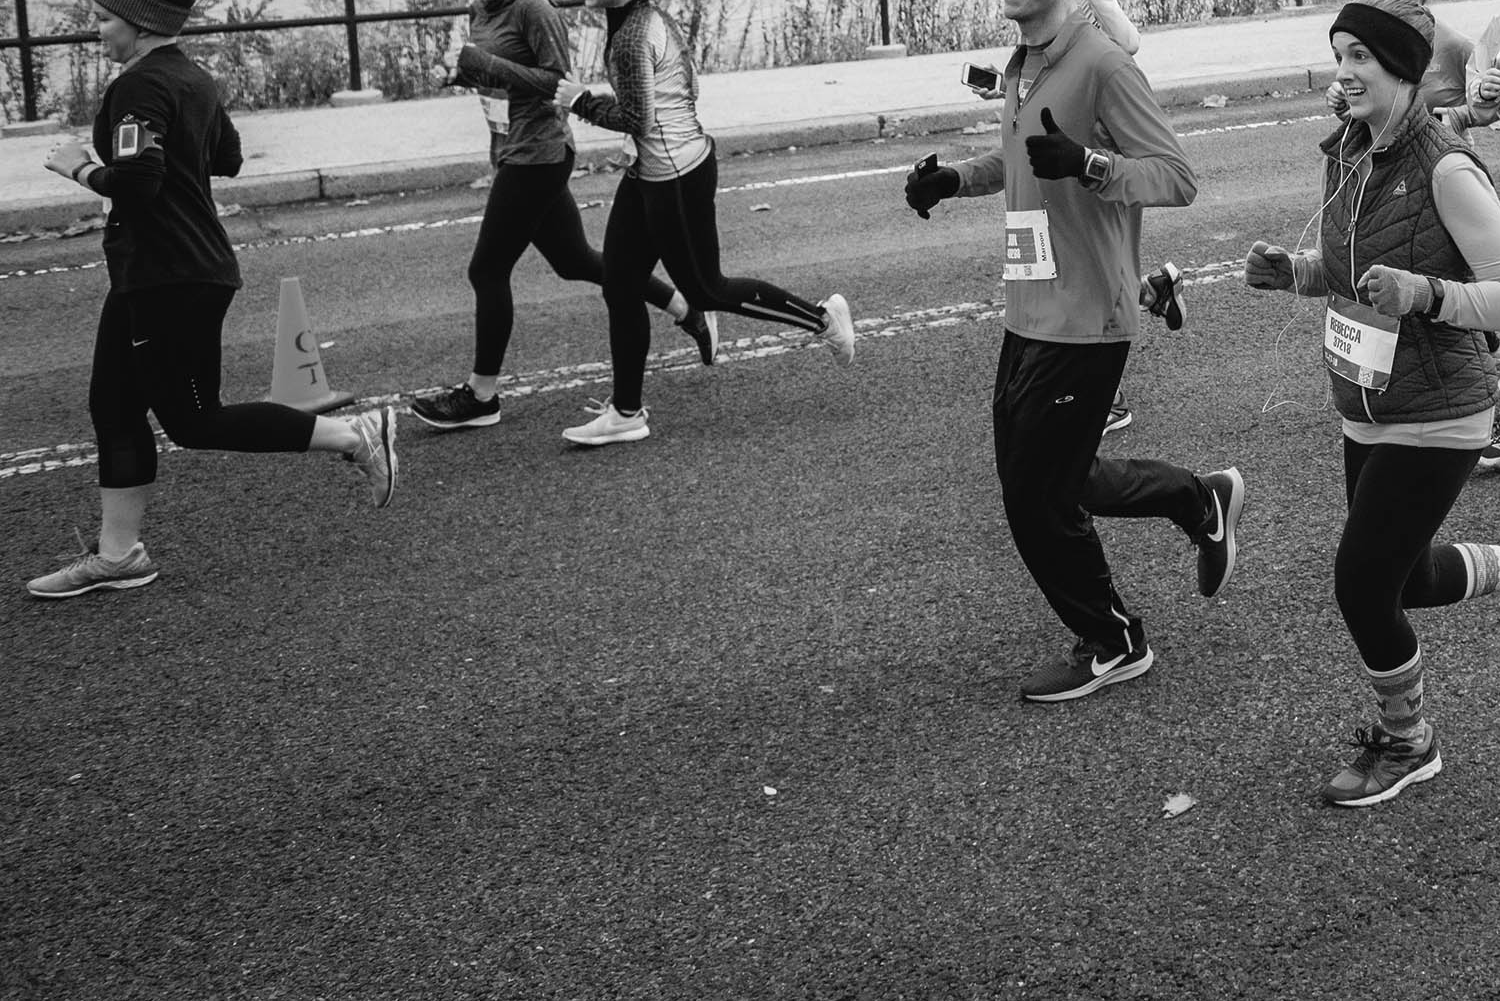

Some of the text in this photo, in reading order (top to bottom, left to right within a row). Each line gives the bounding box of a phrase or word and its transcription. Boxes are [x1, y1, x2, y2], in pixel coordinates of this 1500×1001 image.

[1039, 232, 1048, 262] Maroon
[1330, 316, 1362, 344] REBECCA
[1333, 335, 1352, 355] 37218
